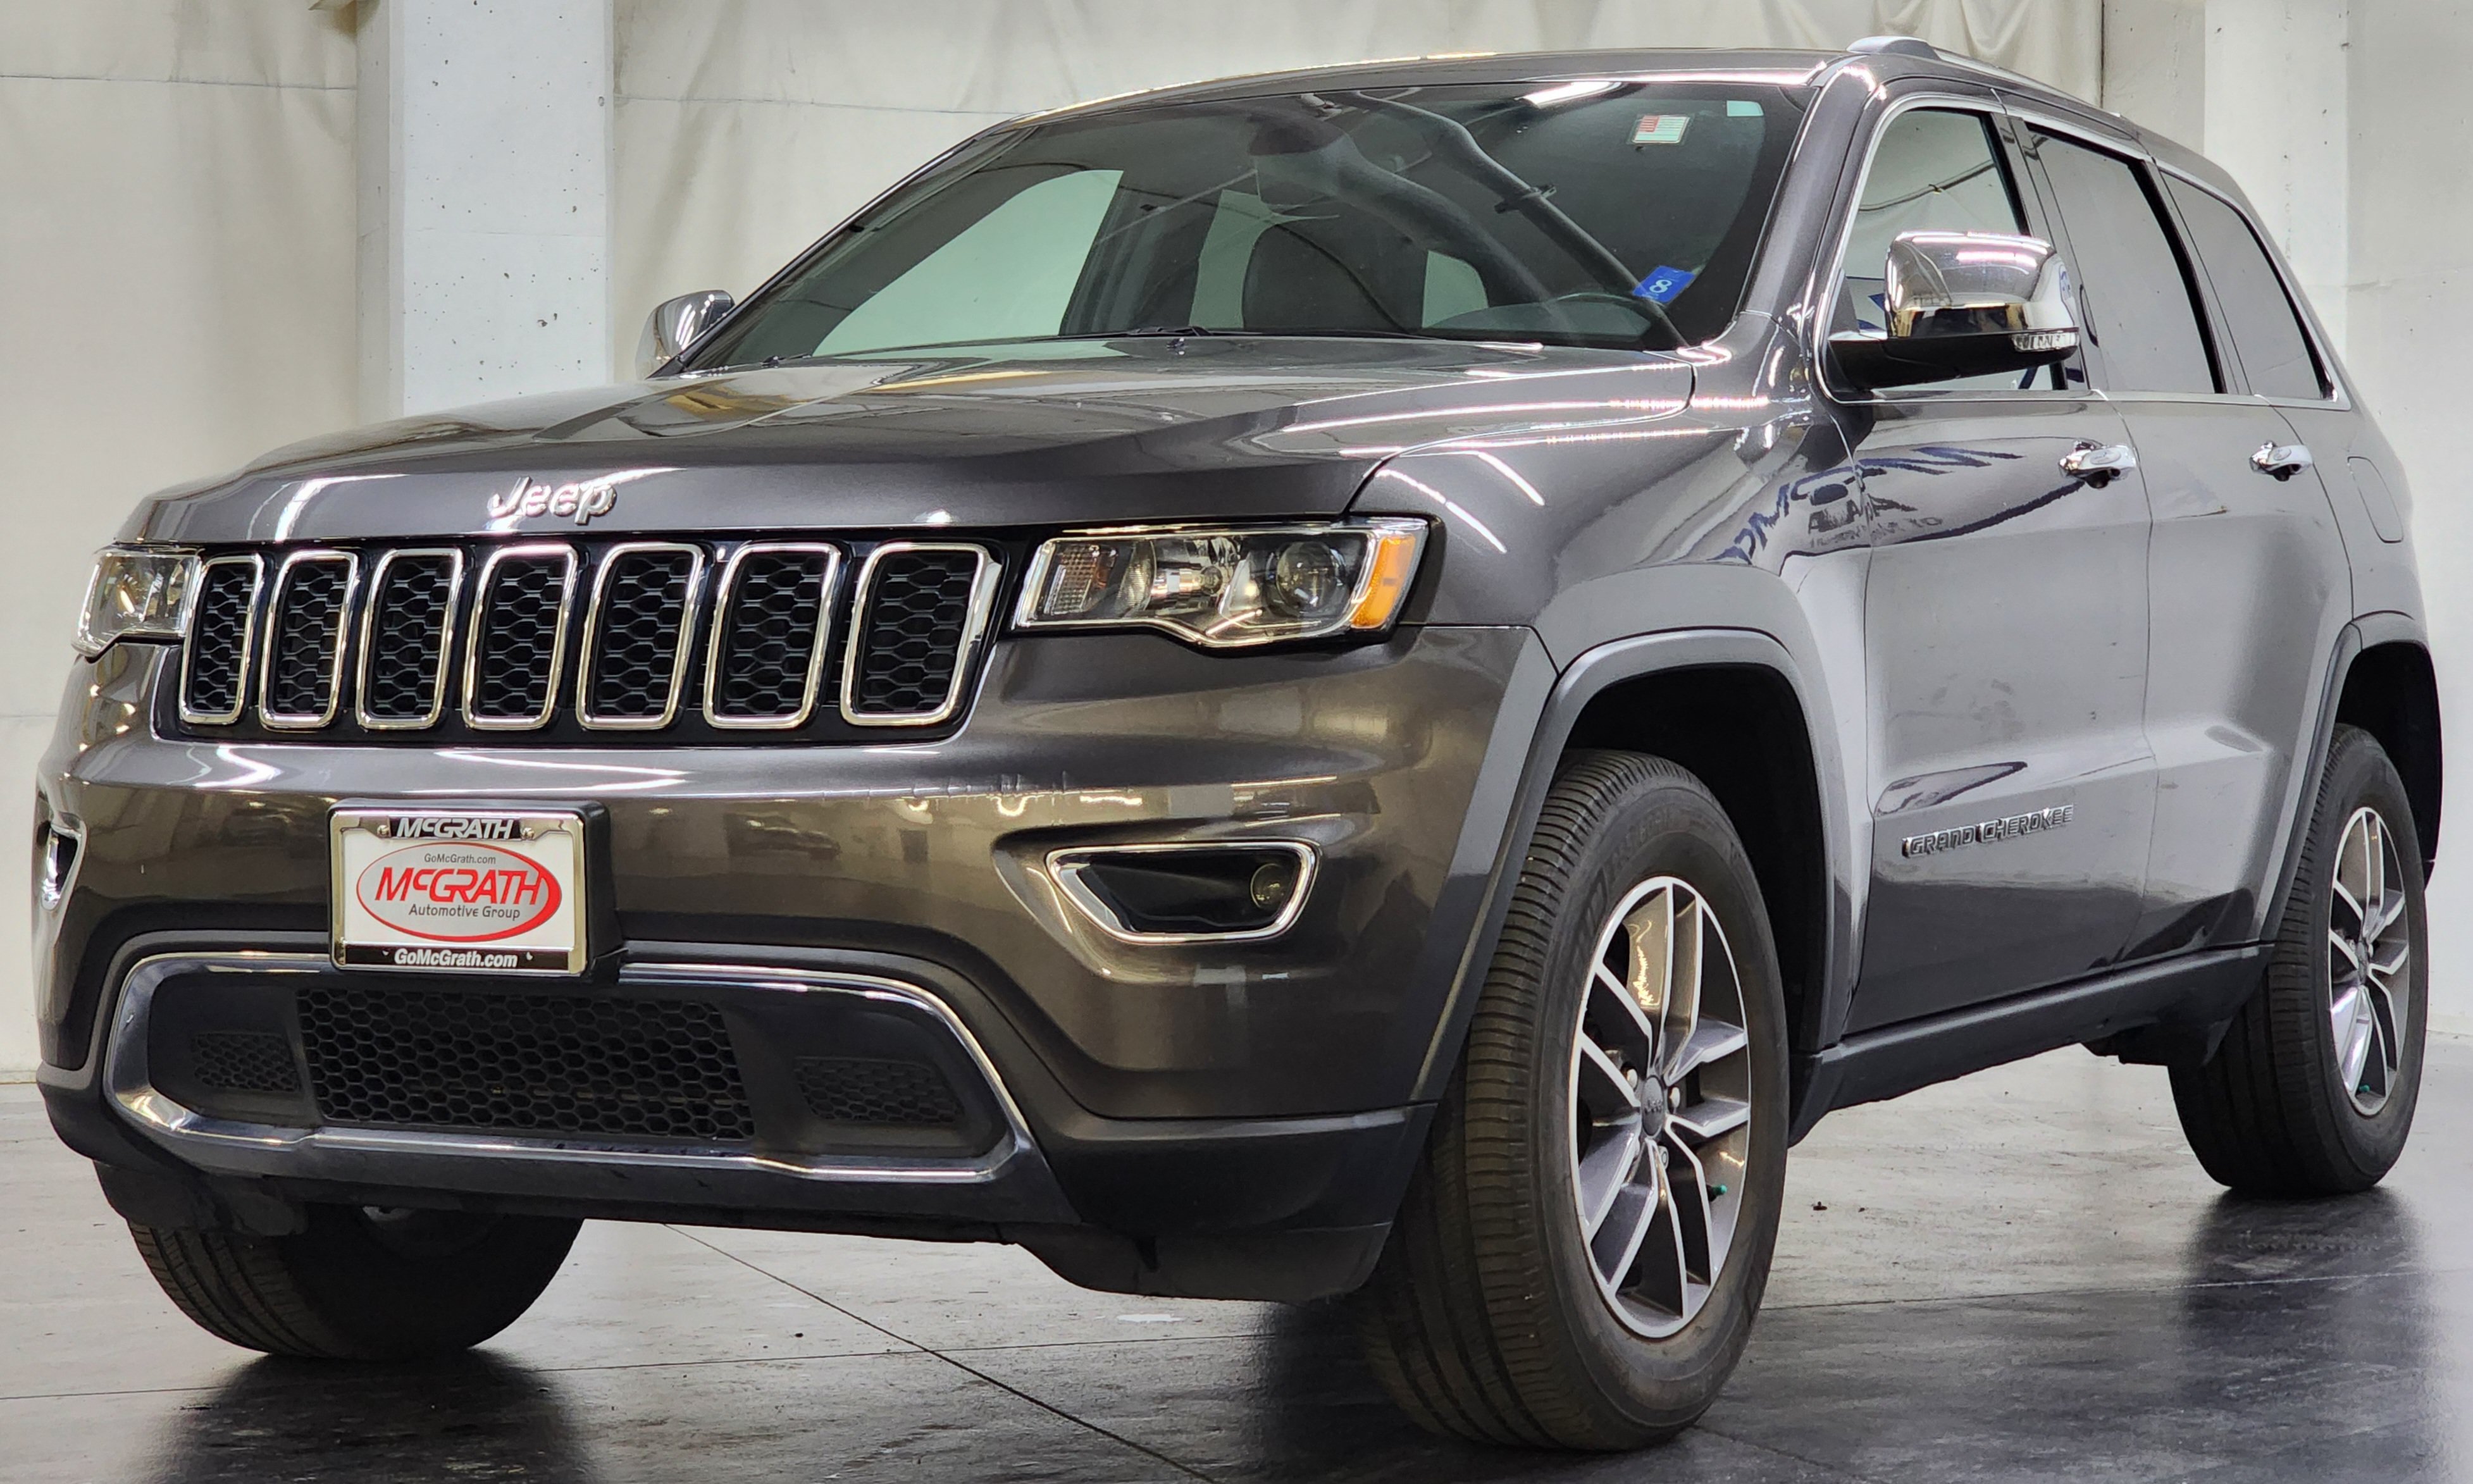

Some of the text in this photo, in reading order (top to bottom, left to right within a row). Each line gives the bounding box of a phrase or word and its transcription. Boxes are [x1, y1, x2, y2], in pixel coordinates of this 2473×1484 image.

[1650, 280, 1672, 293] 8
[488, 476, 617, 525] Jeep
[1902, 805, 2073, 858] GRAND CHEROKEE
[425, 853, 496, 864] GoMcGrath.com
[409, 905, 520, 921] Automotive Group
[395, 948, 518, 968] GoMcGrath.com
